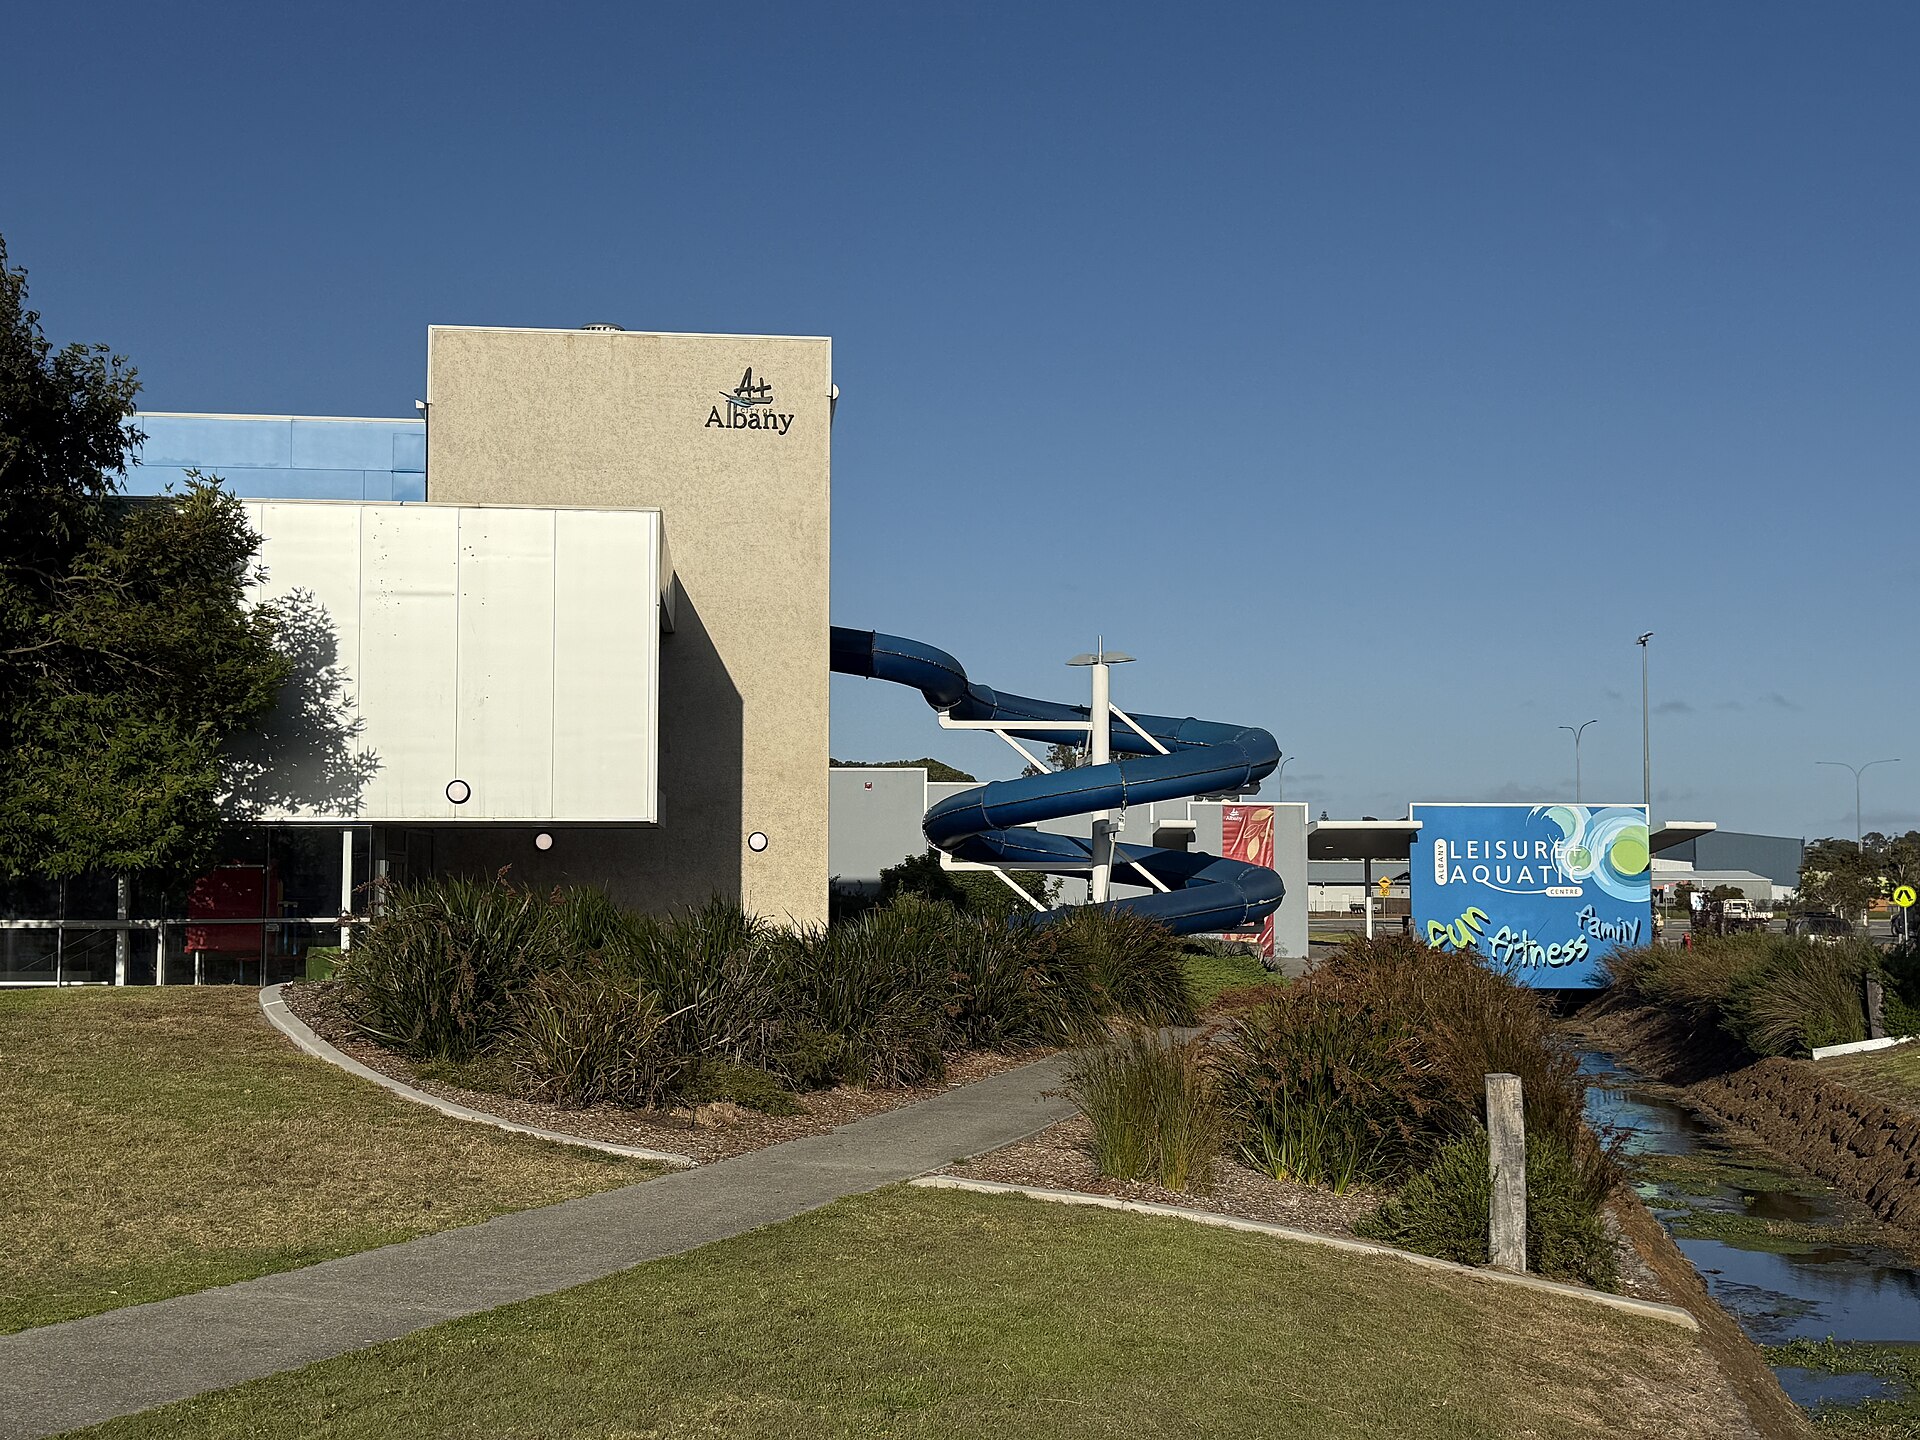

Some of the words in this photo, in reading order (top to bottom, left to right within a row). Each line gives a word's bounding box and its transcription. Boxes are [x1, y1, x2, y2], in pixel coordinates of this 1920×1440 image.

[704, 402, 795, 436] Albany
[1437, 843, 1445, 880] ALBANY
[1449, 865, 1584, 885] AQUATIC
[1426, 906, 1491, 950] fun
[1574, 903, 1641, 944] family
[1487, 925, 1589, 967] fitness
